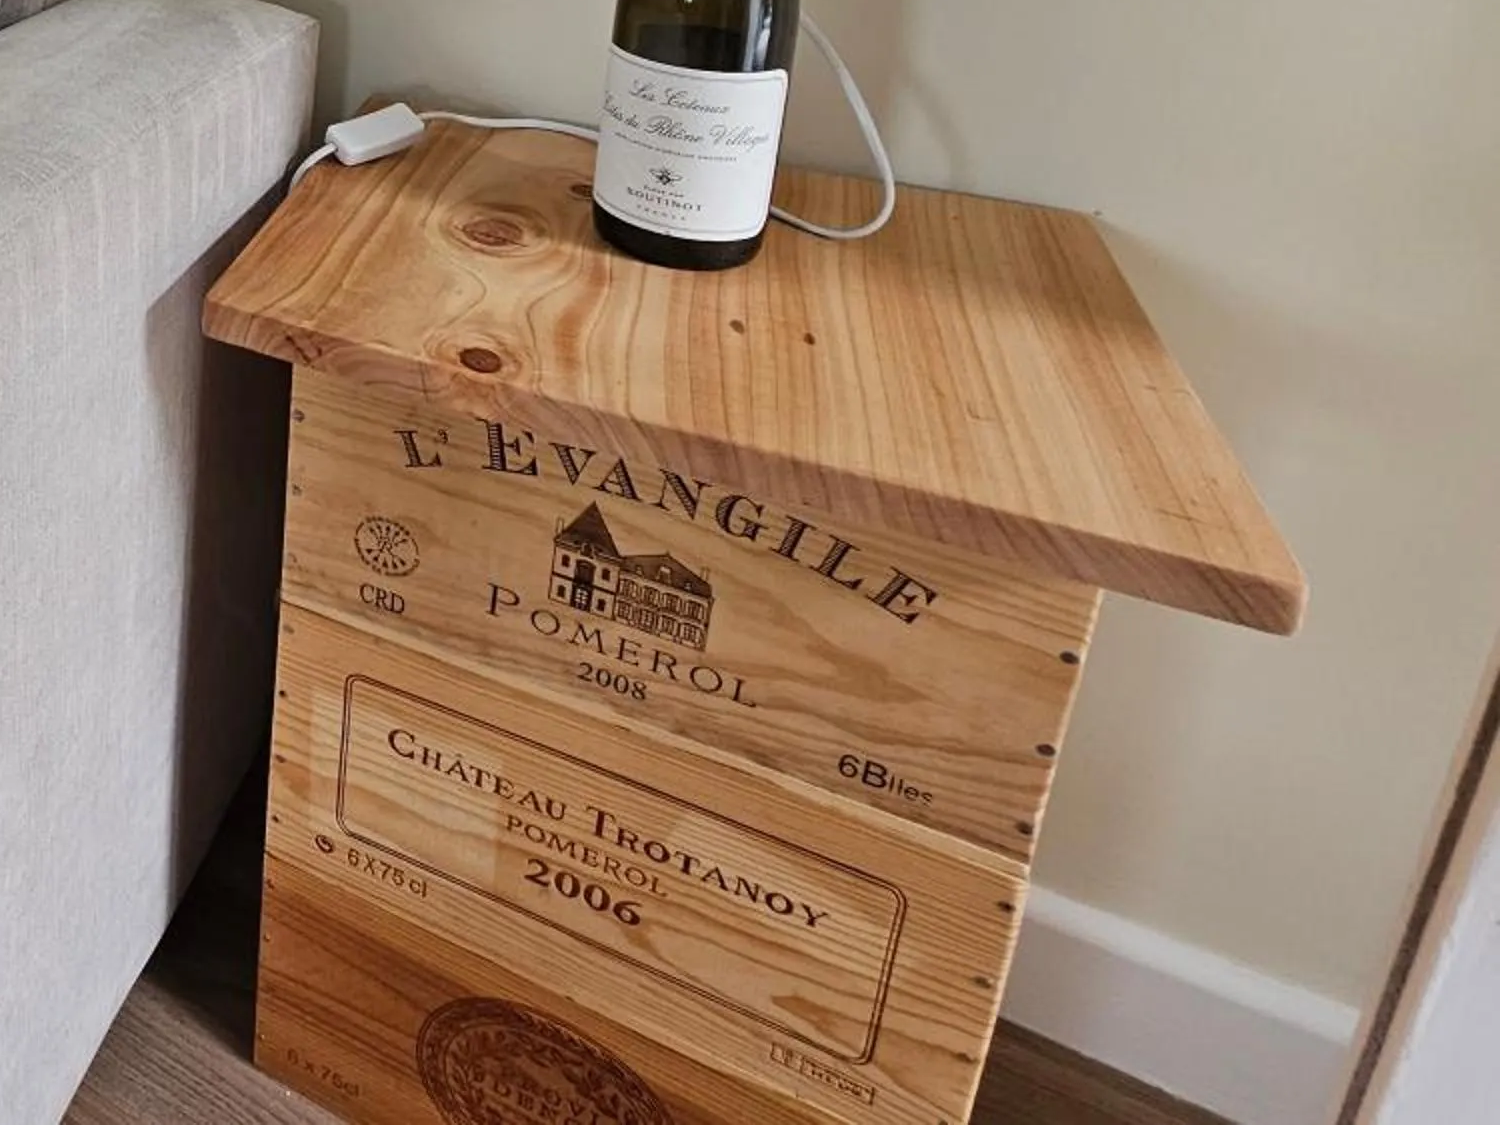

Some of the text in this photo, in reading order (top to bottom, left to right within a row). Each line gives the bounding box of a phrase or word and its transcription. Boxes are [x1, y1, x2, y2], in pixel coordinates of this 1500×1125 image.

[359, 582, 405, 614] CRD
[486, 582, 757, 707] POMEROL
[578, 662, 648, 700] 2008
[387, 728, 828, 927] CHÂTEAU TROTANOY
[506, 814, 668, 897] POMEROL
[524, 858, 644, 926] 2006
